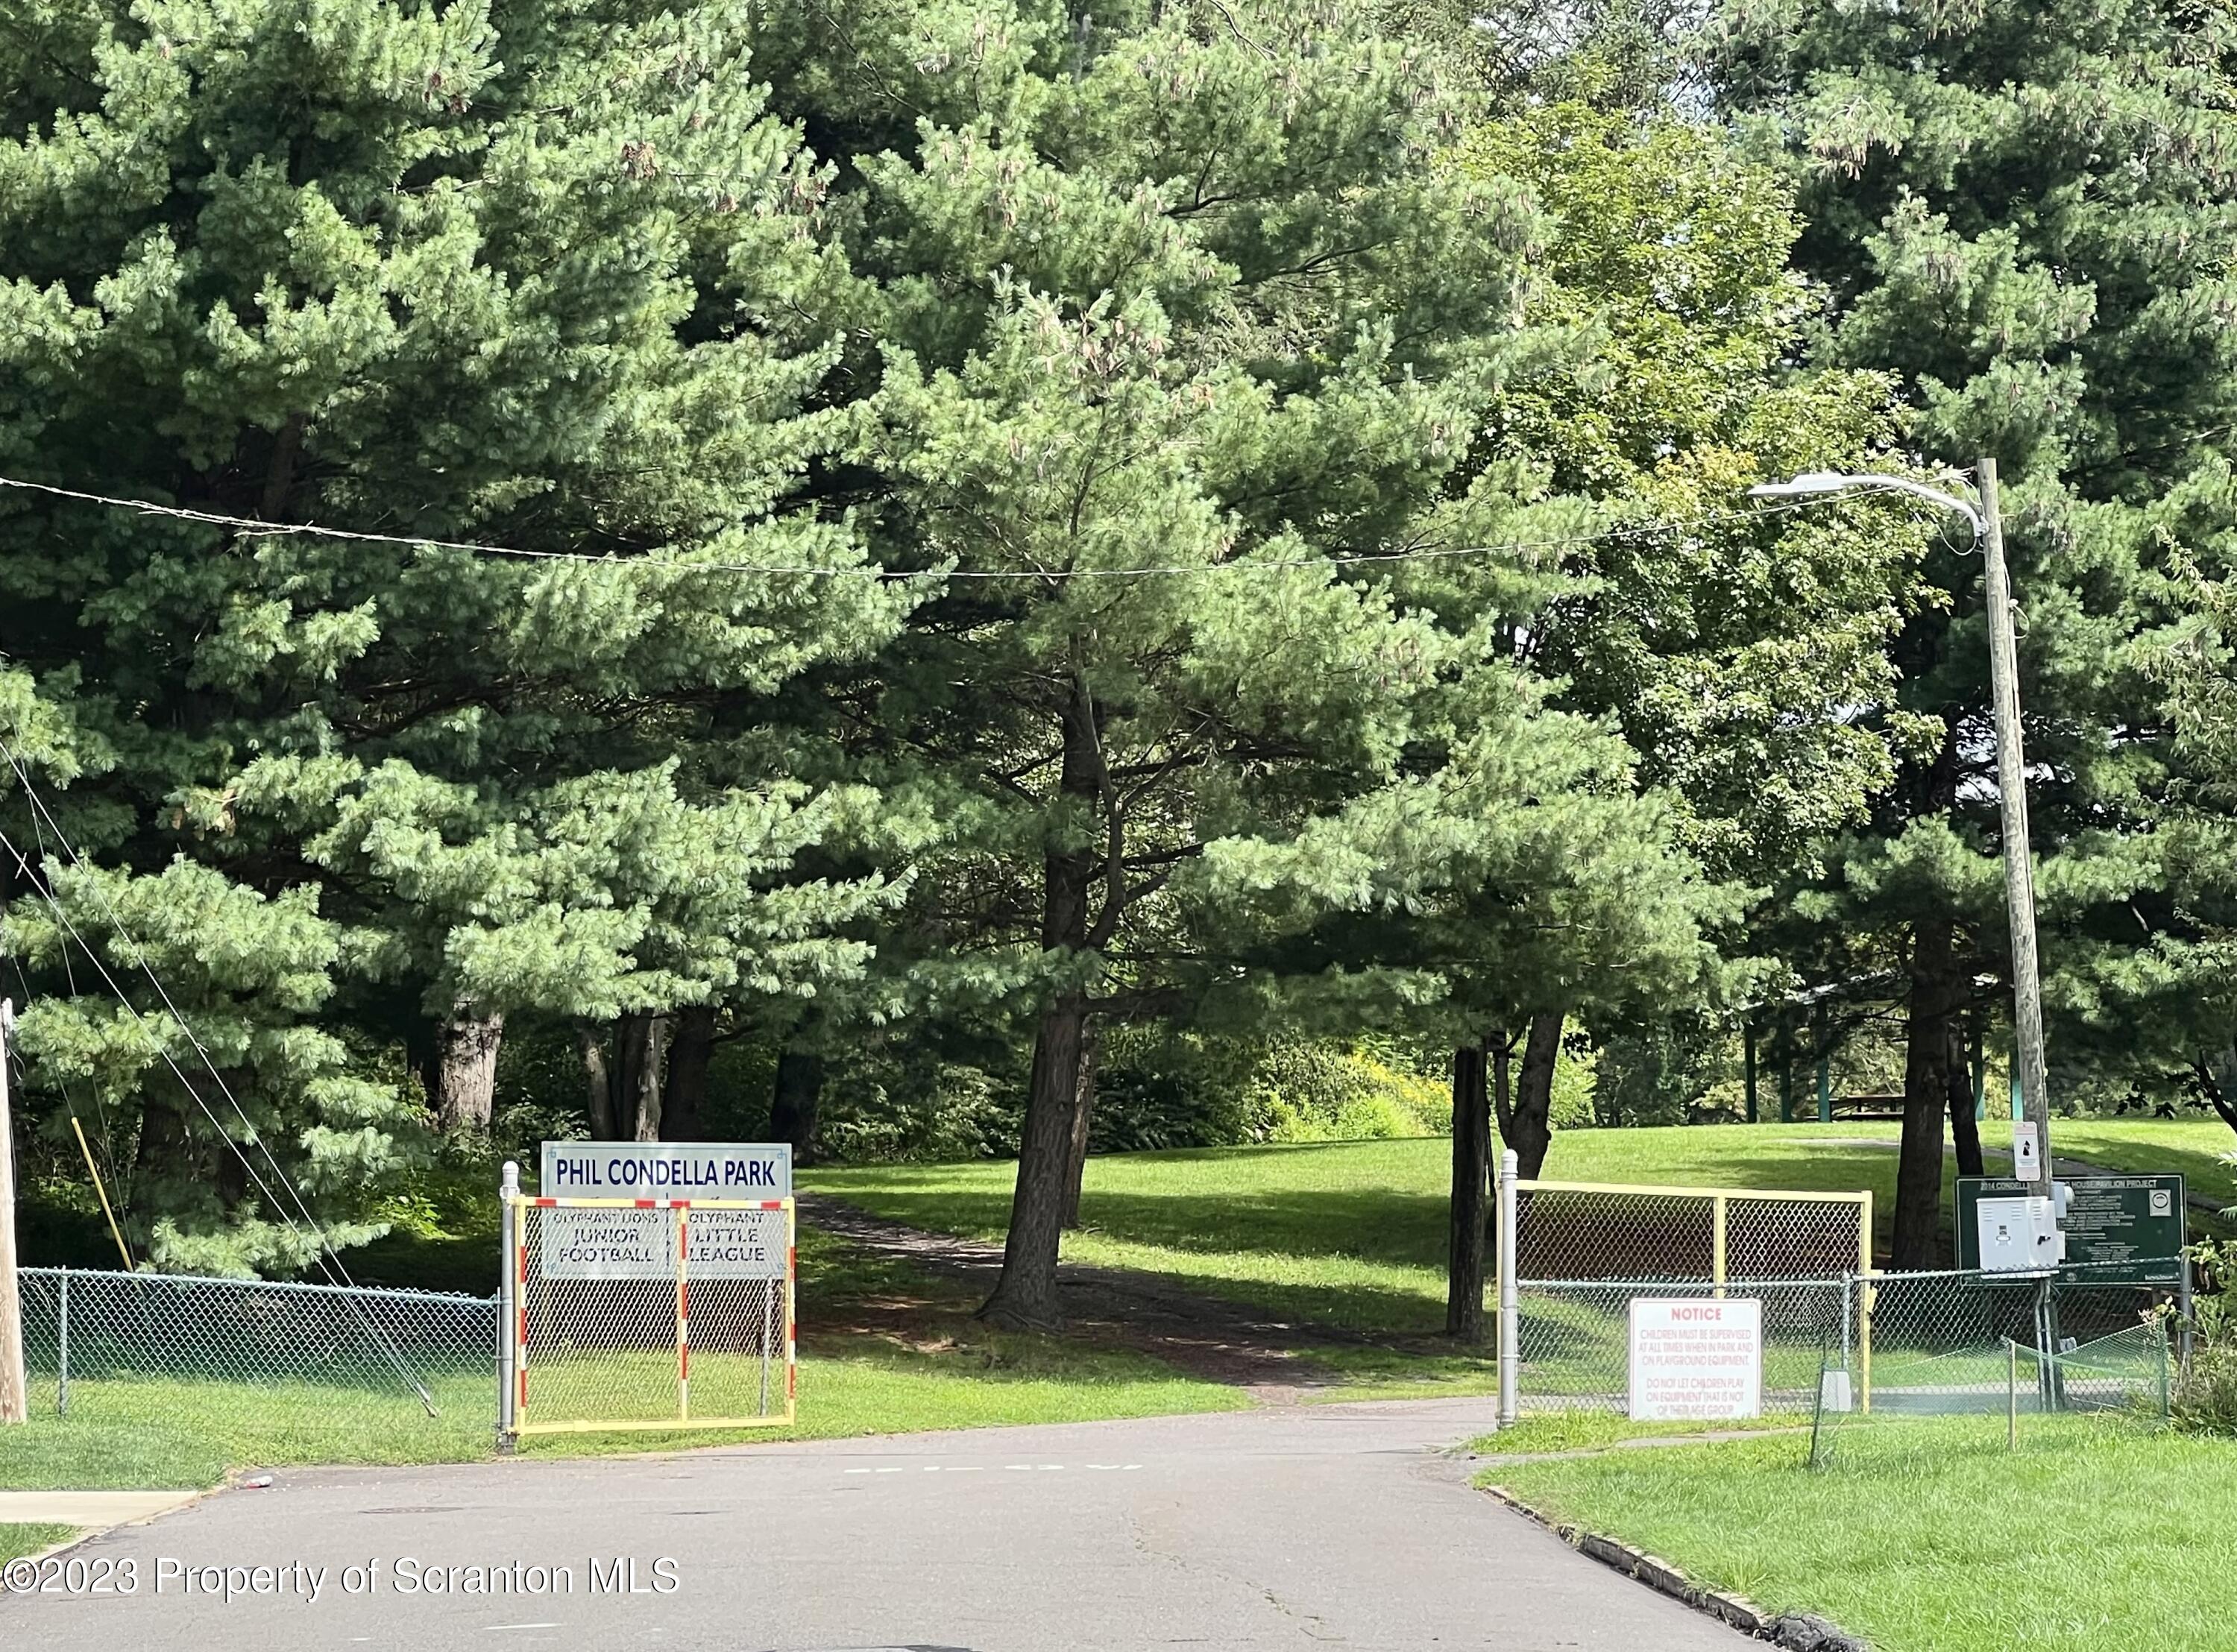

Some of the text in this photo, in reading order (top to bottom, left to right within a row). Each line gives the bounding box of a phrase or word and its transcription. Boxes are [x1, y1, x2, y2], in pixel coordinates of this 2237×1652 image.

[557, 1158, 775, 1186] PHIL CONDELLA PARK
[2126, 1179, 2157, 1189] PROJECT
[689, 1213, 764, 1223] OLYPHANT
[575, 1228, 639, 1246] JUNIOR
[695, 1228, 758, 1243] LITTLE
[560, 1247, 654, 1263] FOOTBALL
[690, 1247, 765, 1262] LEAGUE
[1671, 1308, 1721, 1320] NOTICE
[1640, 1329, 1751, 1340] CHILDREN MUST BE SUPERVISED
[1639, 1343, 1753, 1352] AT ALL TIMES WHEN IN PARK AND
[1642, 1355, 1654, 1366] ON
[1656, 1355, 1706, 1366] PLAYGROUND
[1646, 1378, 1744, 1388] DO NOT LET CHILDREN PLAY
[1646, 1392, 1744, 1402] ON EQUIPMENT THAT IS NOT
